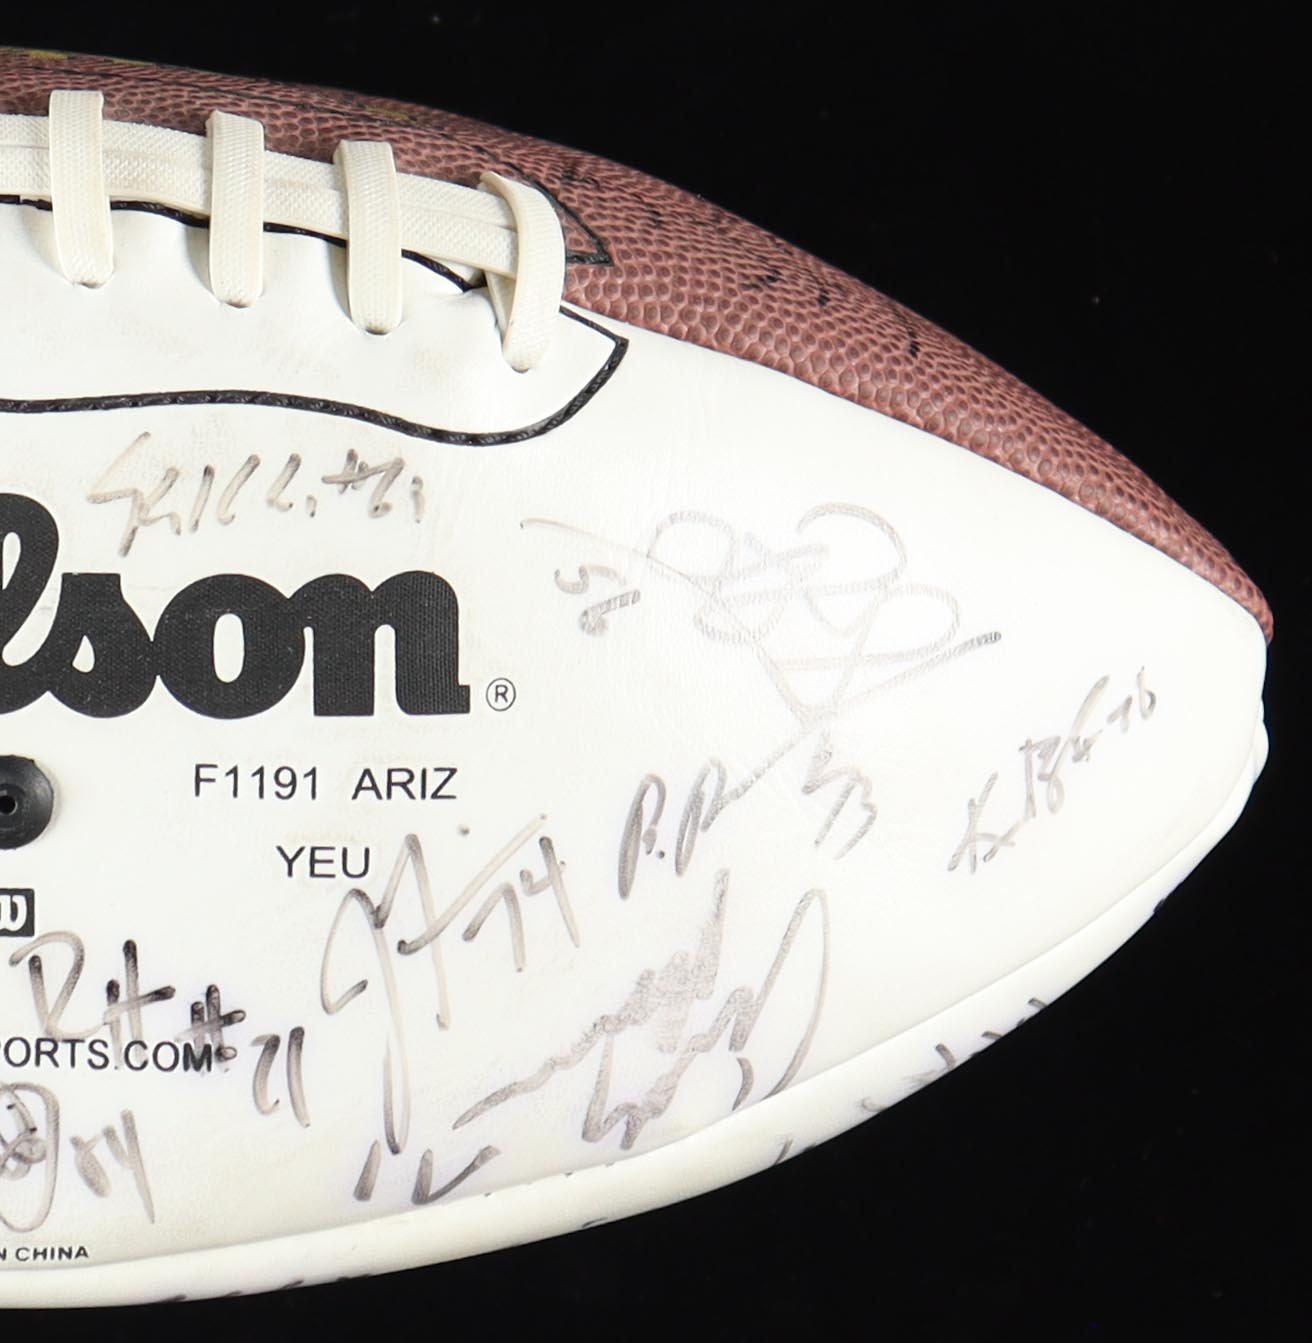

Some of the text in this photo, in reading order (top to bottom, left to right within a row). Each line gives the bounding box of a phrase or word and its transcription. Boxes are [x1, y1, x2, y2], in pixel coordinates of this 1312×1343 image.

[194, 764, 457, 801] F1191 ARIZ
[277, 846, 370, 878] YEU
[15, 1244, 90, 1262] CHINA
